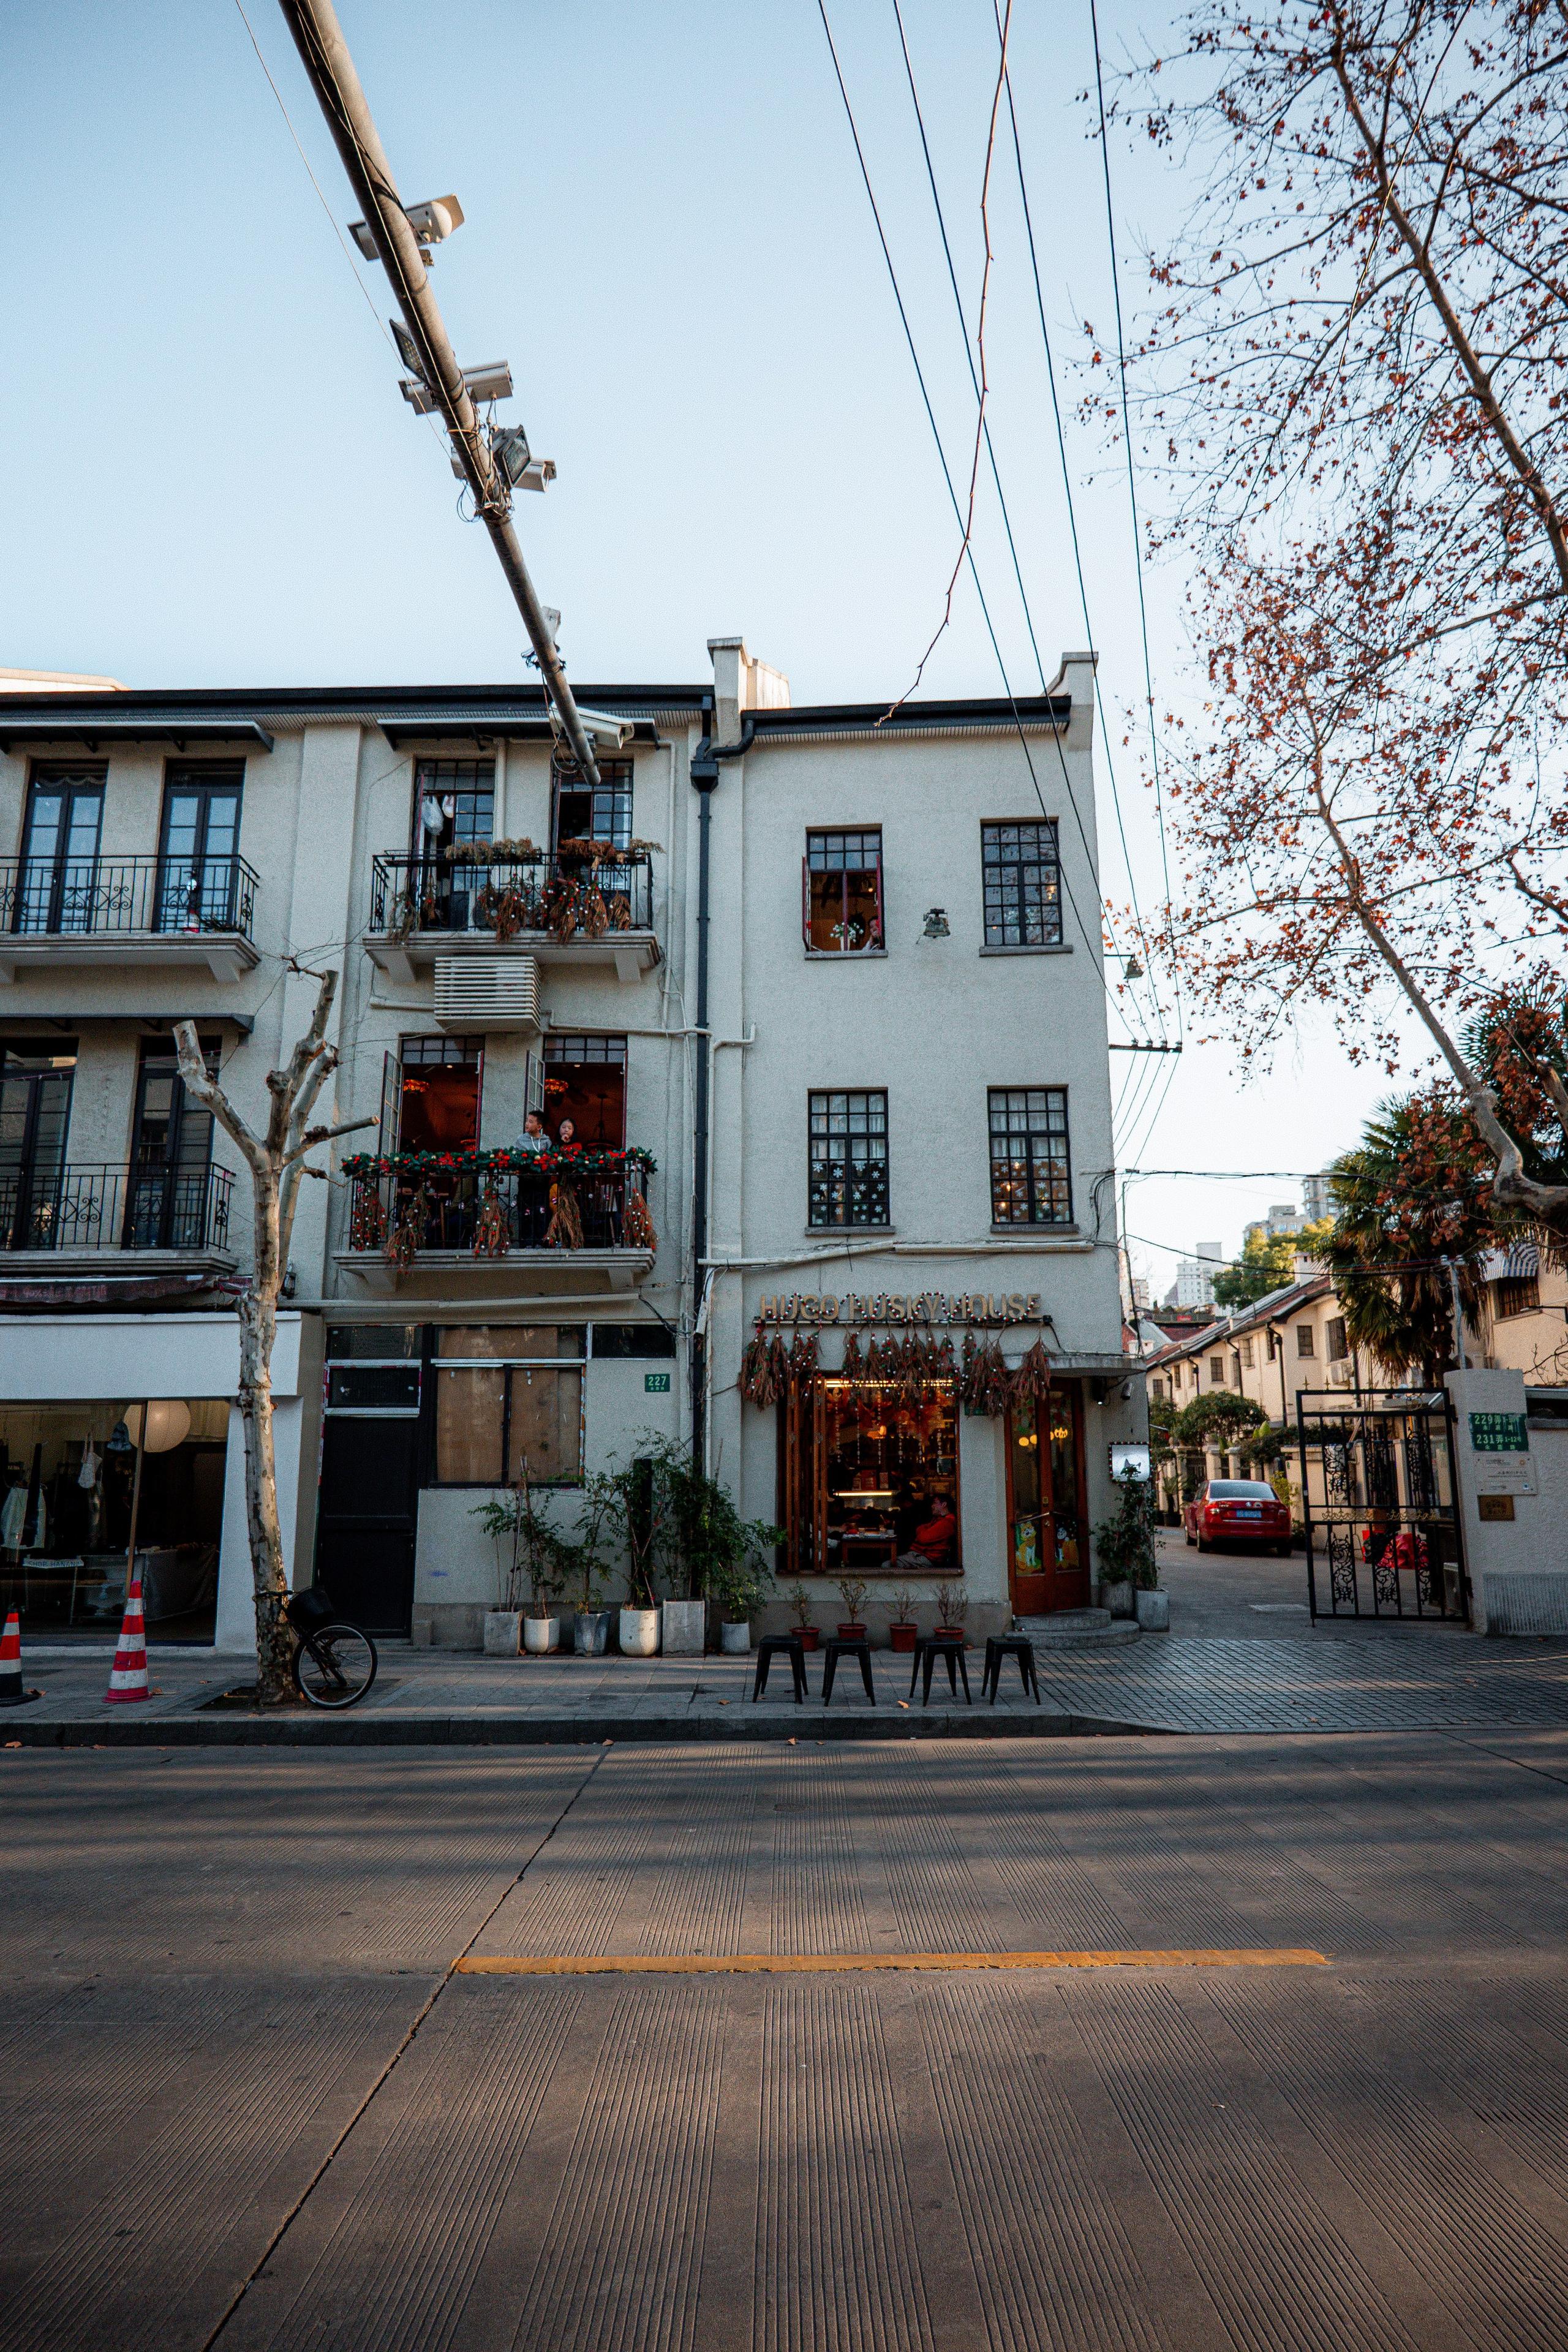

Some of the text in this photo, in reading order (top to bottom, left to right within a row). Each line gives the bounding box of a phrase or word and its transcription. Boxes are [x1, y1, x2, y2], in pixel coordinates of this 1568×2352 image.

[760, 1293, 1041, 1321] HUGO HUSKY HOUSE
[648, 1376, 666, 1386] 227
